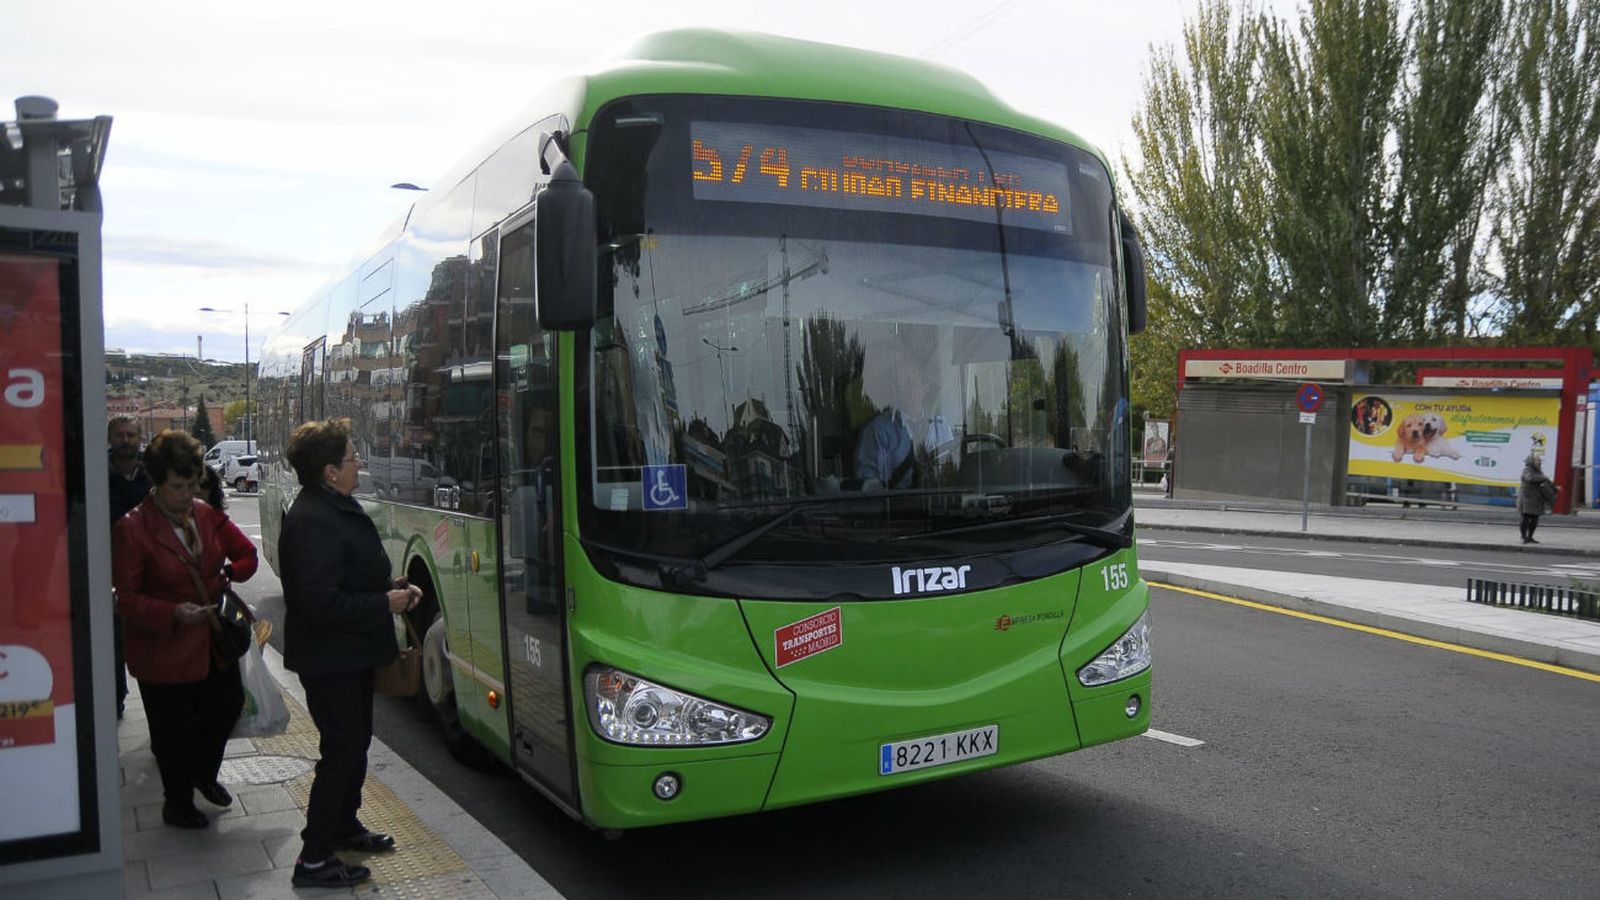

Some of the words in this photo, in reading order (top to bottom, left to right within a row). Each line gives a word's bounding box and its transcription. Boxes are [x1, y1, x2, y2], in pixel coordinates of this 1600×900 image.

[1235, 362, 1273, 375] Boadilla
[1275, 362, 1308, 376] Centro
[1414, 403, 1432, 412] CON
[1434, 404, 1445, 412] TU
[1446, 405, 1472, 413] AYUDA
[891, 564, 971, 595] Irizar
[1100, 563, 1128, 591] 155
[782, 623, 837, 651] TRANSPORTES
[793, 612, 837, 636] CONSORCIO
[524, 633, 542, 667] 155
[807, 634, 838, 653] MADRID
[896, 740, 947, 768] 8221
[956, 729, 993, 756] KKX
